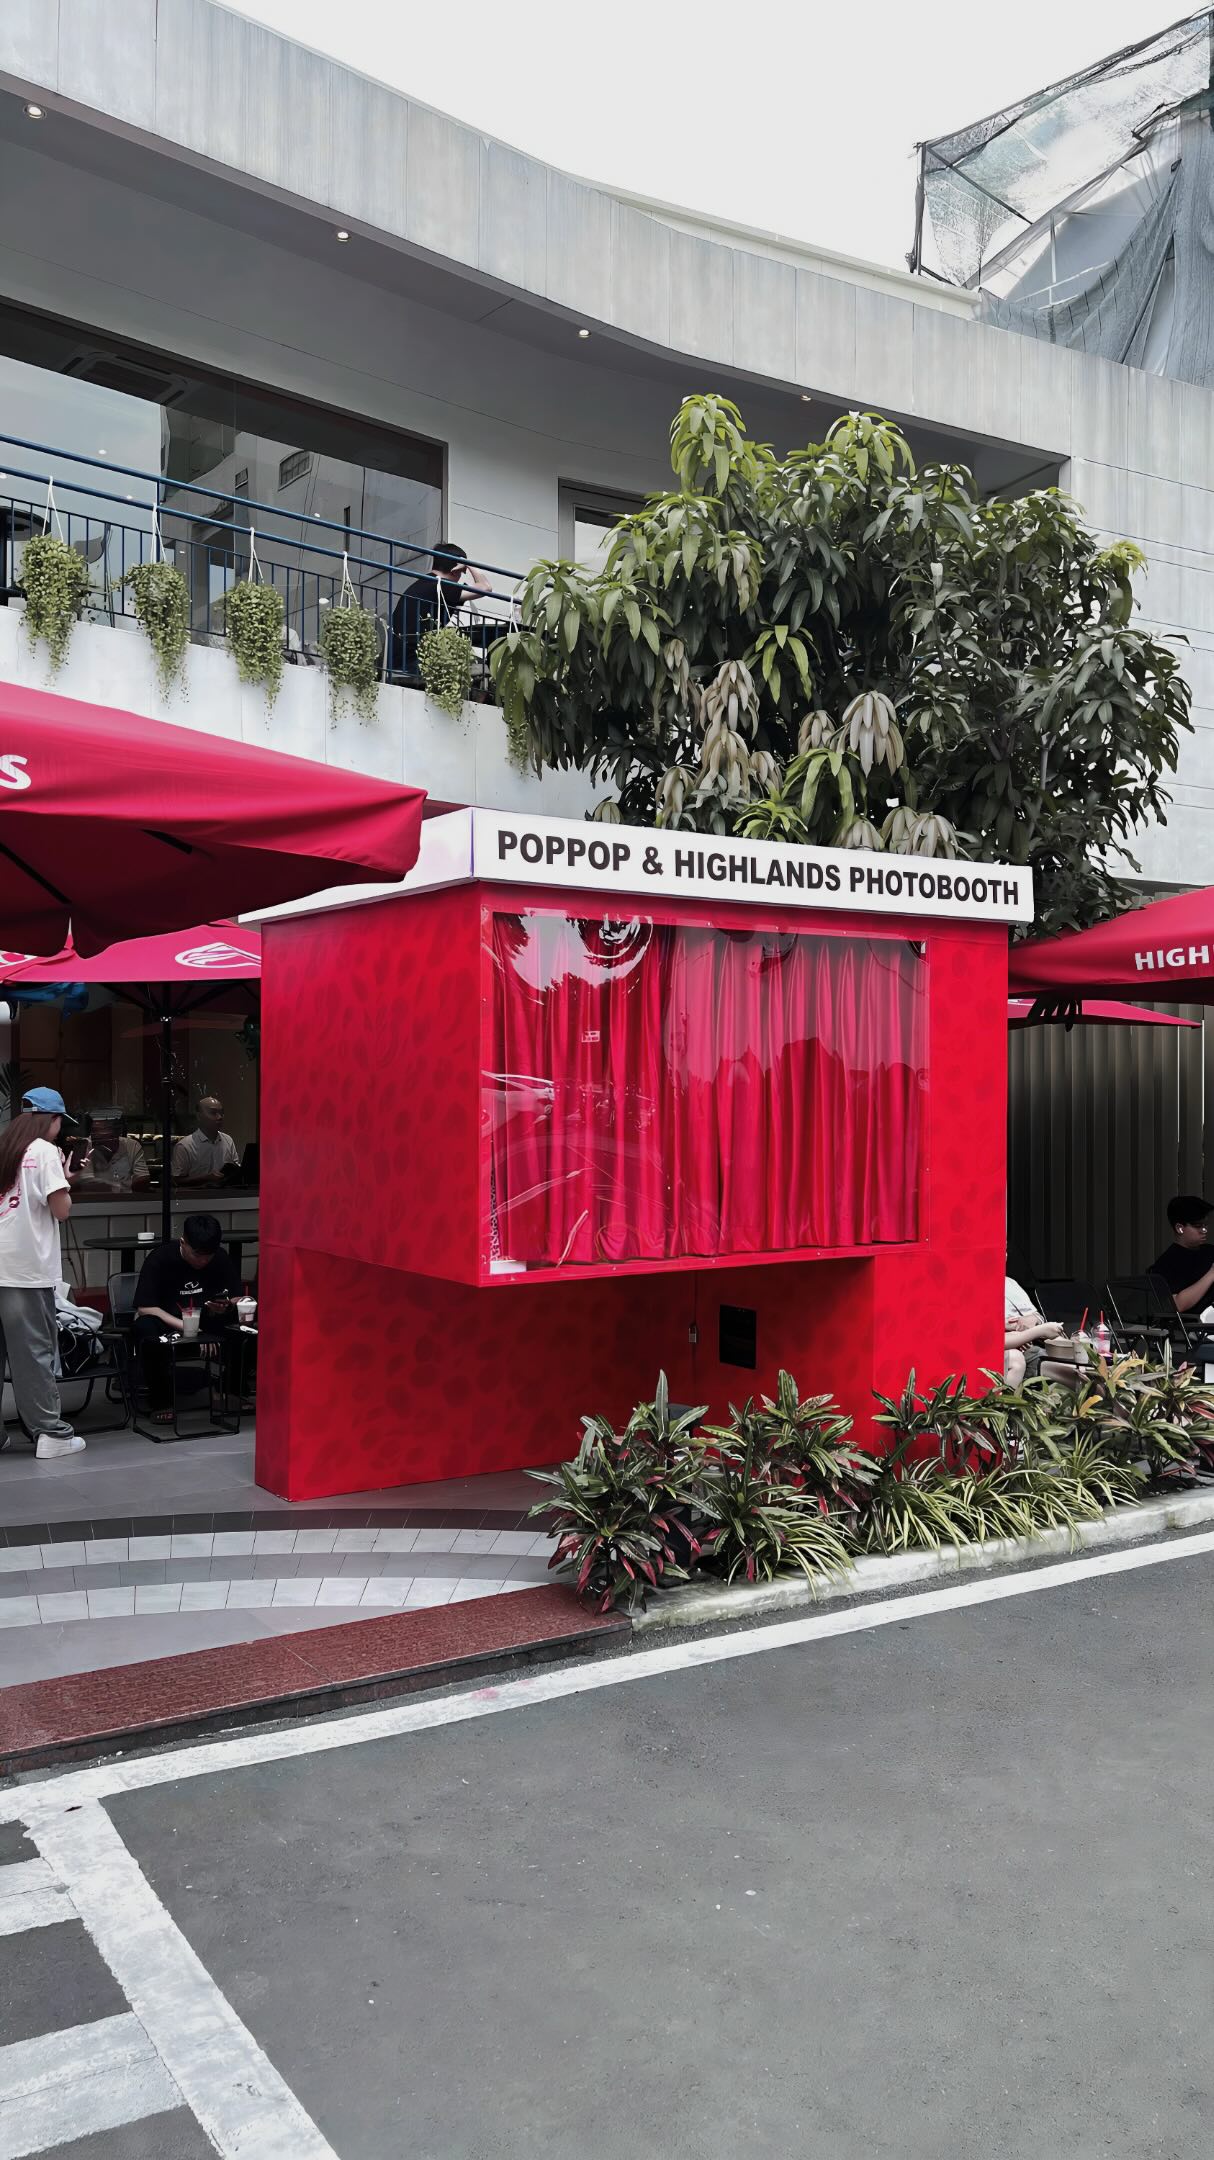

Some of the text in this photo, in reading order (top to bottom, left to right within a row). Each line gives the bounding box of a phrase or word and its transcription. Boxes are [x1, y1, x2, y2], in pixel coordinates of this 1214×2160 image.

[498, 830, 1019, 905] POPPOP & HIGHLANDS PHOTOBOOTH
[1135, 944, 1214, 970] HIGH
